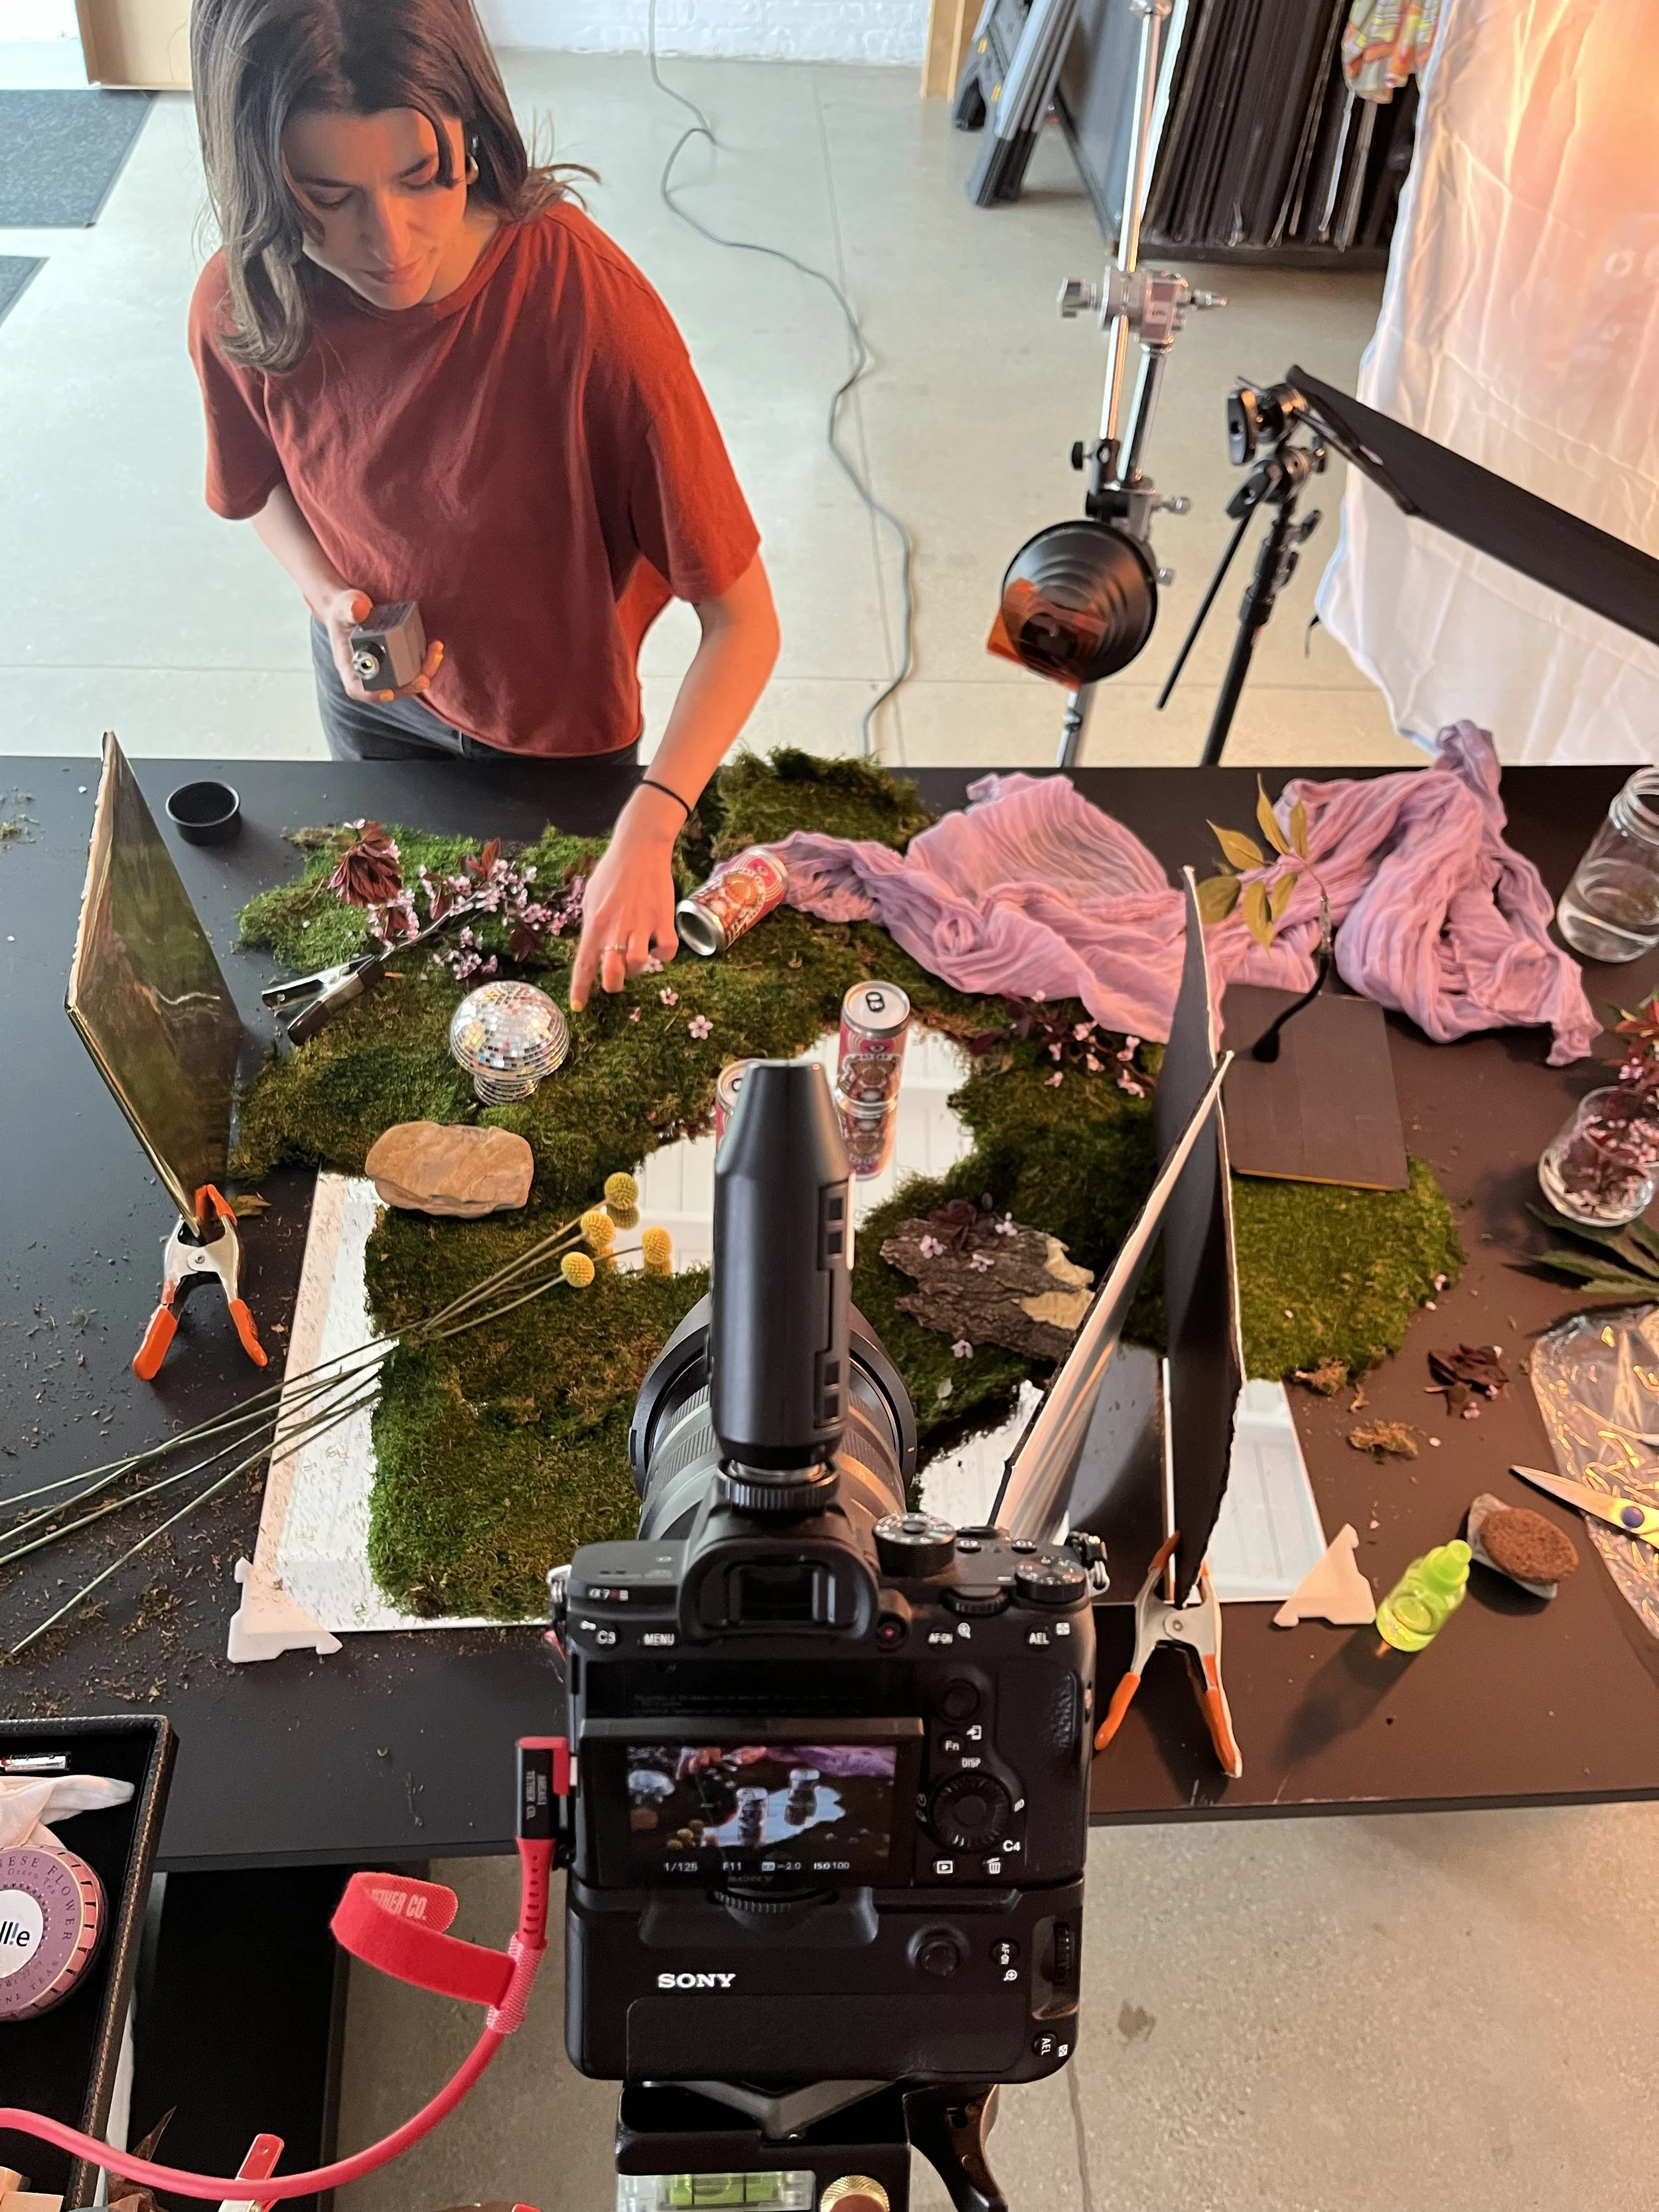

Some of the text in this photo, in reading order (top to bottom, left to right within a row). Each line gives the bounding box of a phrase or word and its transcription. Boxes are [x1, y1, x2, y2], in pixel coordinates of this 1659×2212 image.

[597, 1630, 616, 1645] C3
[643, 1633, 675, 1646] MENU
[945, 1740, 960, 1751] Fn
[962, 1757, 981, 1768] DISP
[1003, 1840, 1021, 1852] C4
[46, 1864, 76, 1941] FLOWER
[658, 1973, 736, 1988] SONY
[1041, 2037, 1052, 2055] AEL
